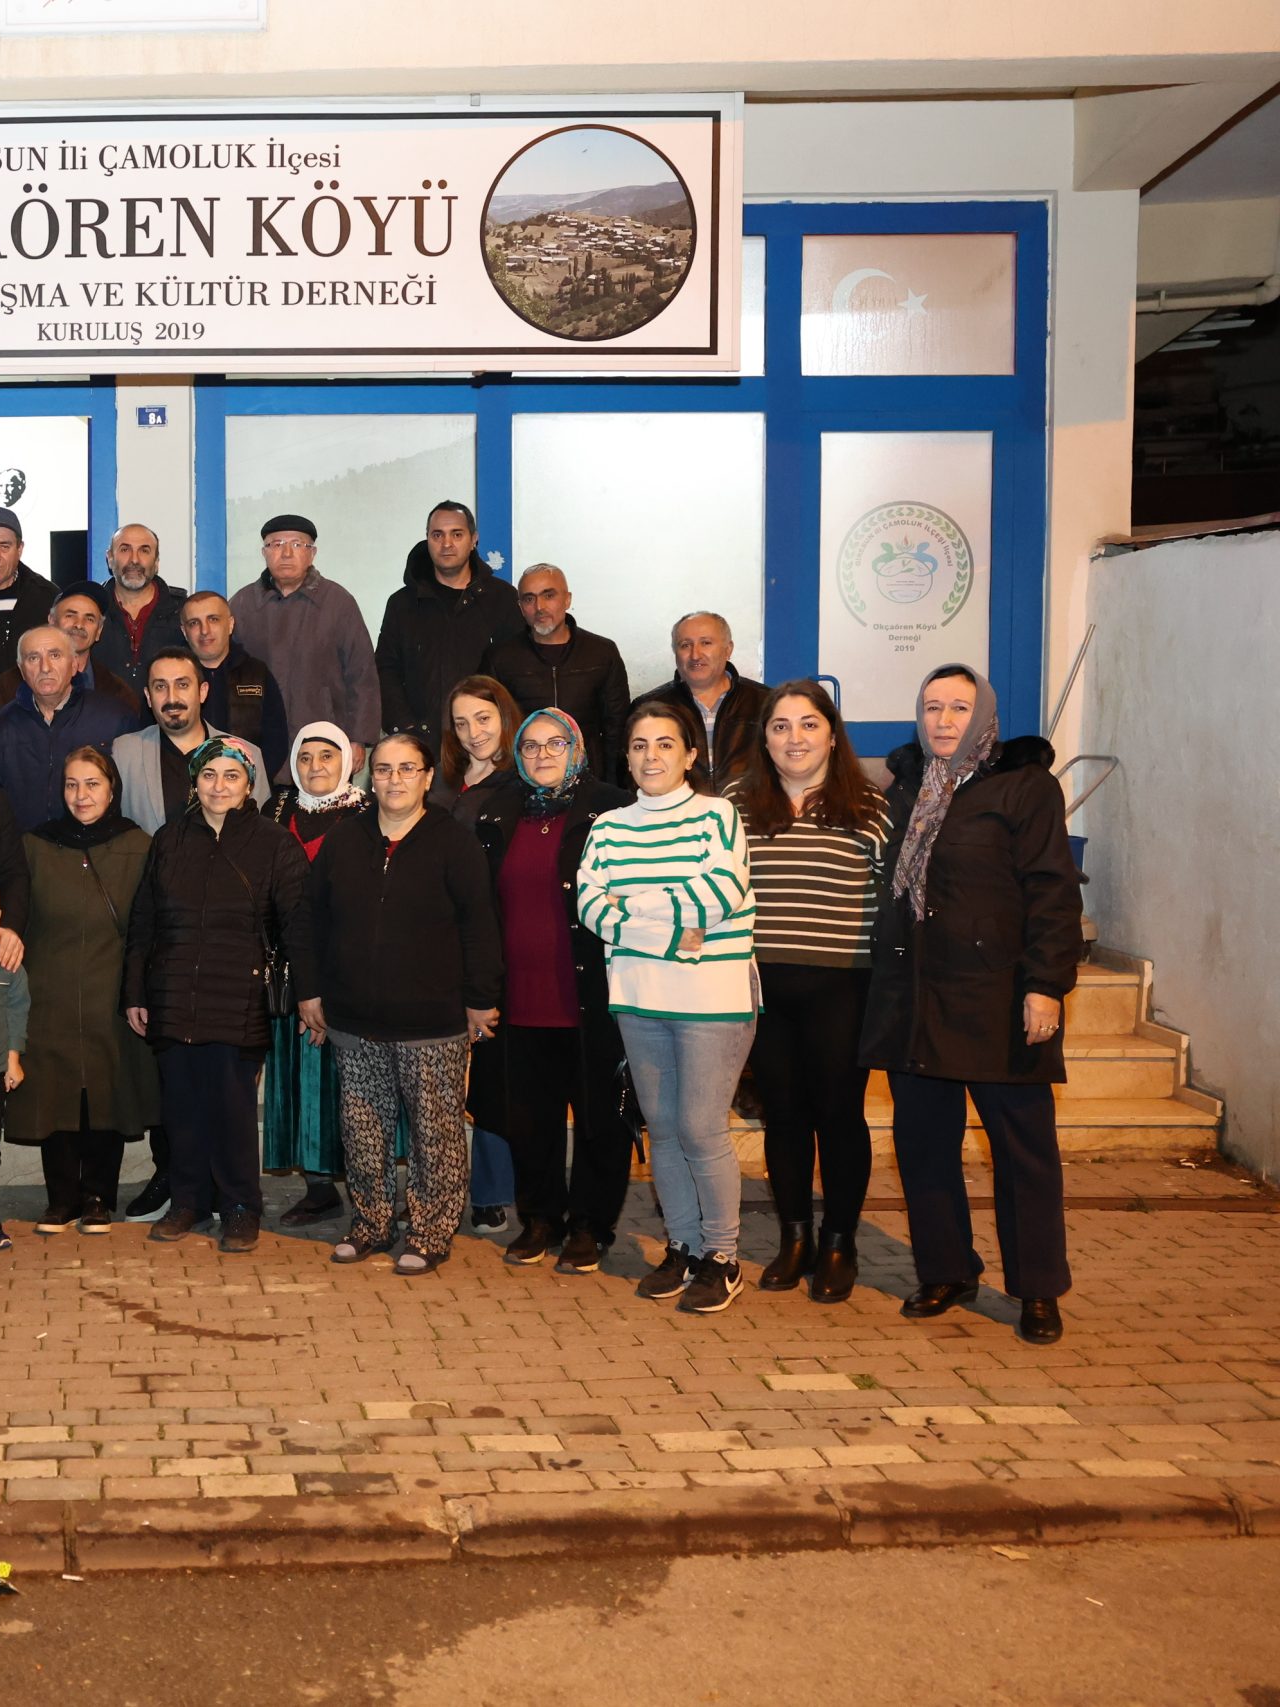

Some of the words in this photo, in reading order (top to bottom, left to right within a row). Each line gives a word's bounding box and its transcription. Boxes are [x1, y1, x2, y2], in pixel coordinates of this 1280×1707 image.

[58, 139, 88, 171] İli
[98, 143, 257, 177] ÇAMOLUK
[266, 137, 341, 176] İlçesi
[245, 179, 459, 258] KÖYÜ
[81, 282, 124, 308] VE
[135, 275, 271, 307] KÜLTÜR
[281, 273, 437, 306] DERNEĞİ
[37, 322, 143, 346] KURULUŞ
[154, 322, 205, 341] 2019
[894, 644, 916, 652] 2019
